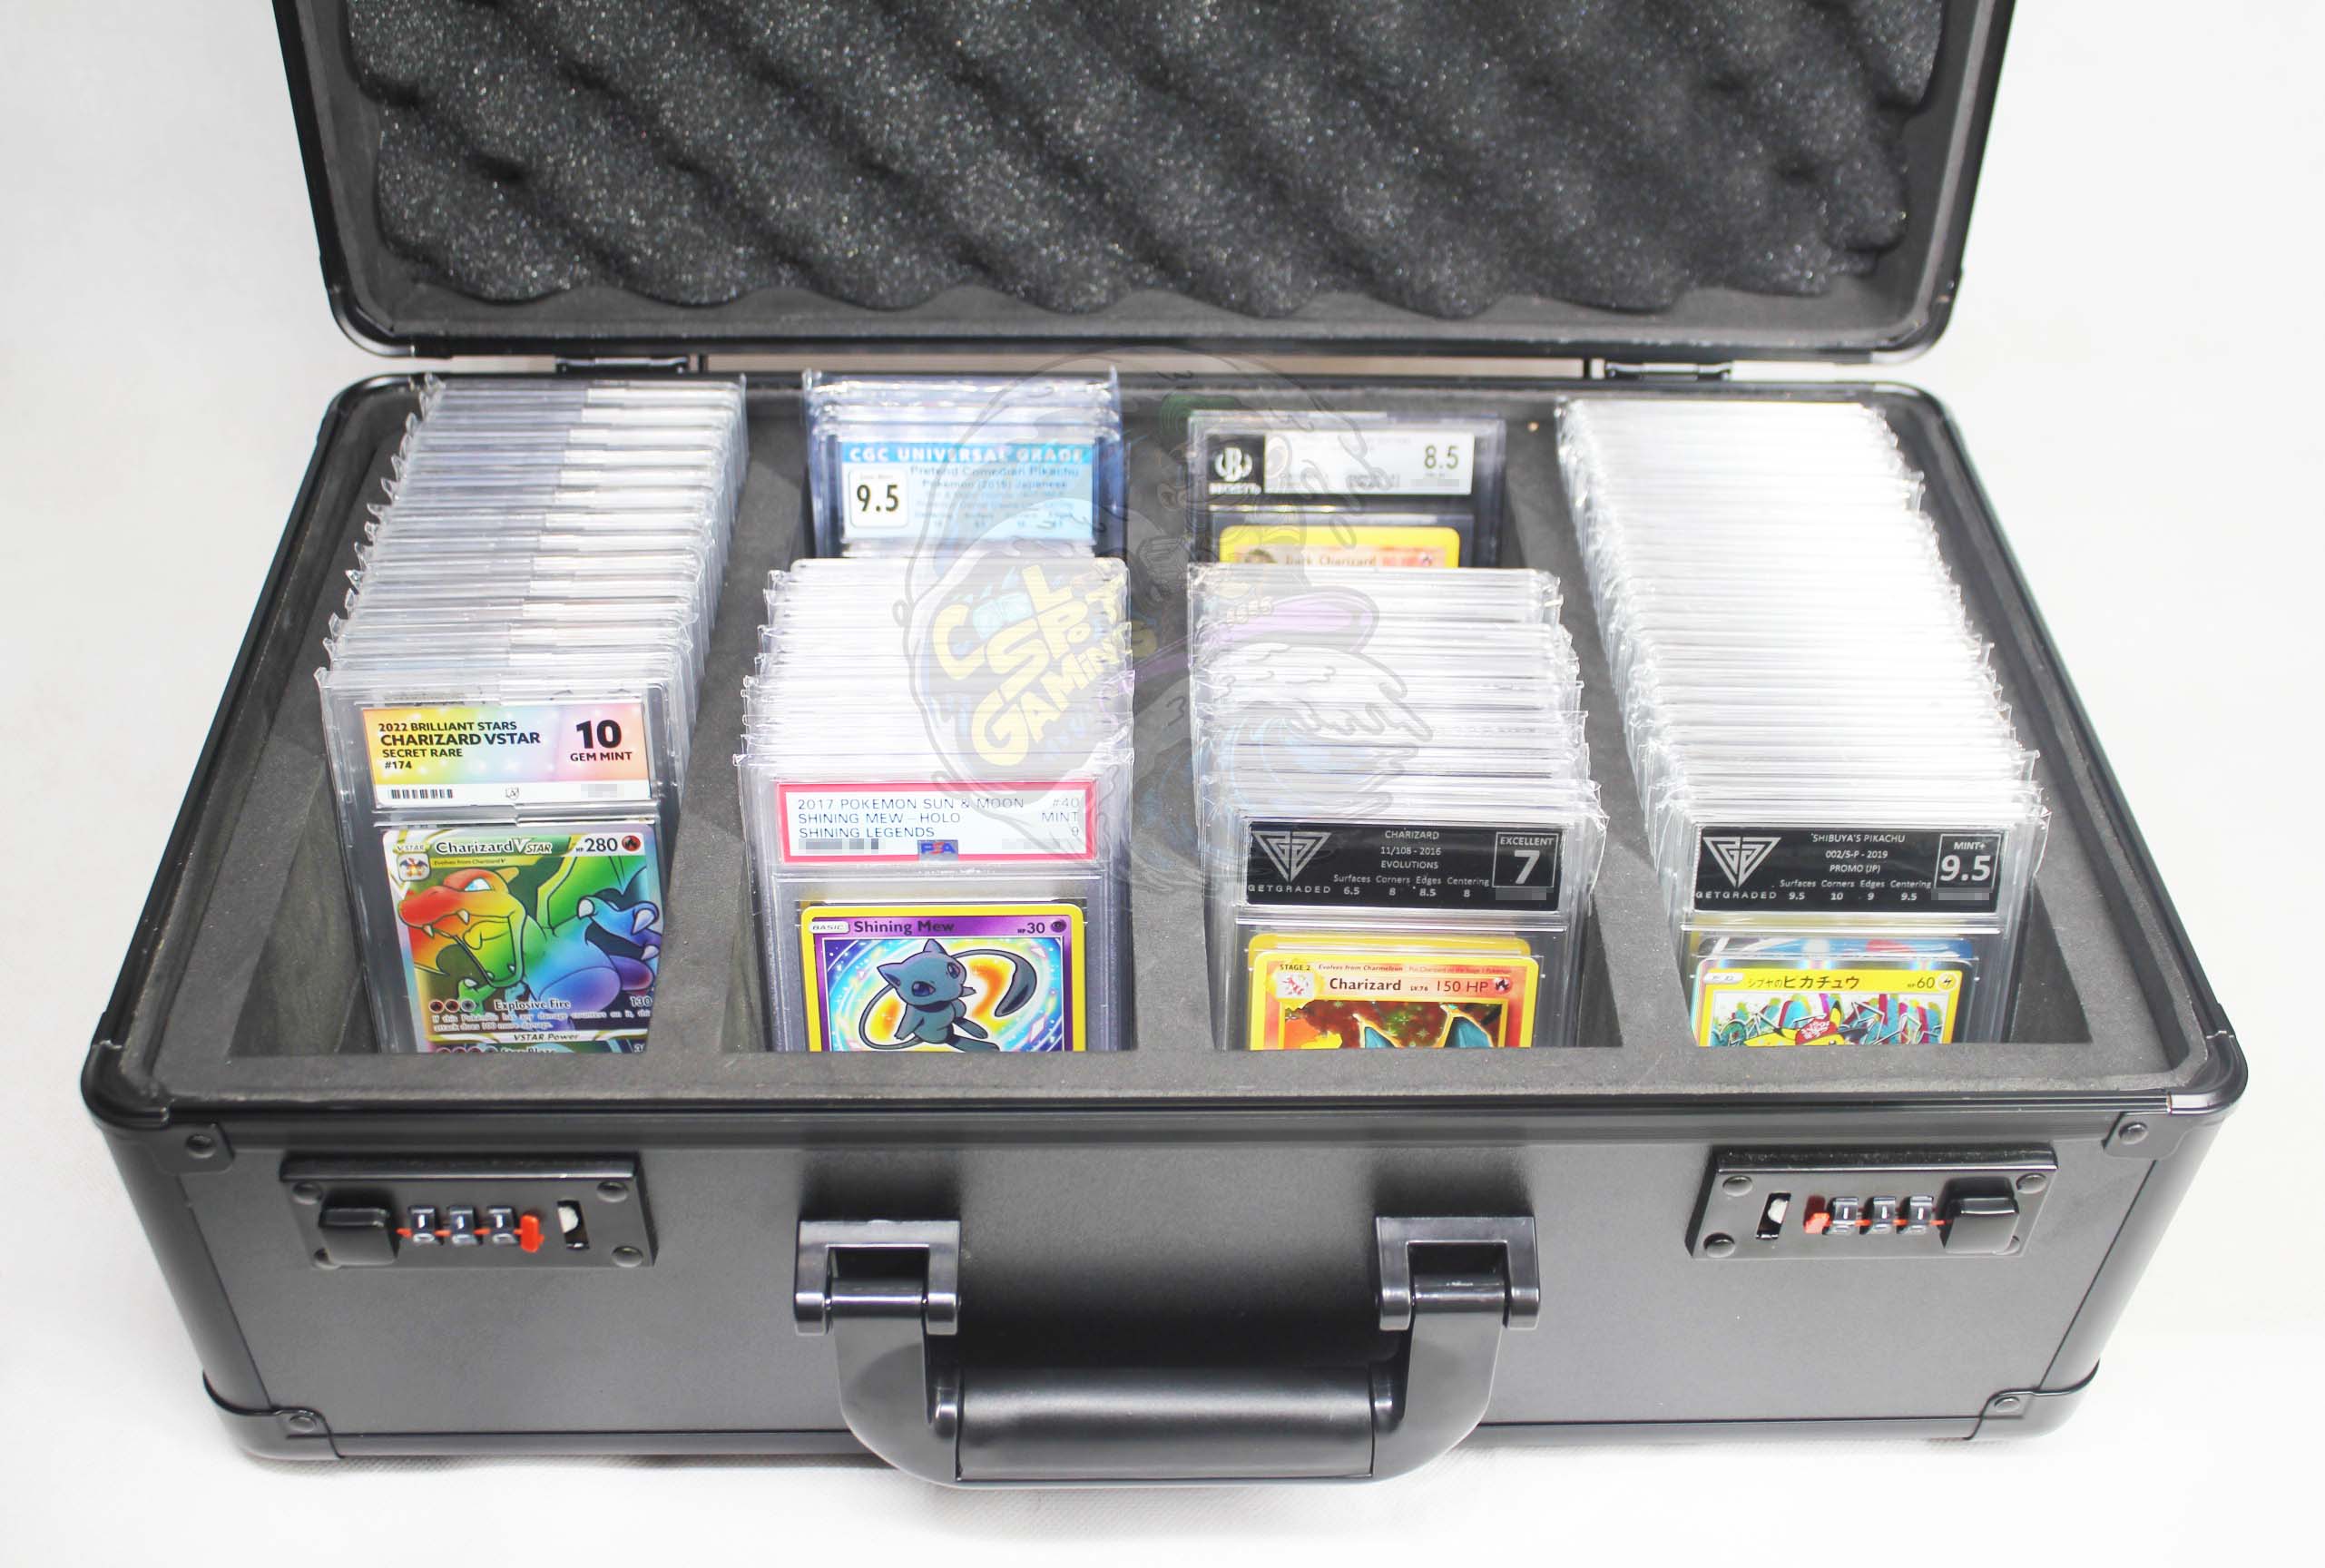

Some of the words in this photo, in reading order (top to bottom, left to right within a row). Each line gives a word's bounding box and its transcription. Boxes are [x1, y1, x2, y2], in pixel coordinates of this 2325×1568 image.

[849, 447, 888, 463] CGC
[1424, 444, 1459, 470] 8.5
[856, 484, 900, 513] 9.5
[378, 722, 408, 732] 2022
[410, 721, 475, 731] BRILLIANT
[477, 721, 517, 730] STARS
[380, 733, 482, 746] CHARIZARD
[485, 732, 541, 745] VSTAR
[575, 718, 623, 750] 10
[382, 748, 427, 759] SECRET
[430, 748, 464, 758] RARE
[570, 751, 599, 763] GEM
[600, 750, 633, 761] MINT
[384, 760, 412, 769] #174
[798, 799, 835, 810] 2017
[840, 799, 918, 810] POKEMON
[923, 798, 955, 809] SUN
[961, 798, 971, 808] &
[977, 798, 1025, 808] MOON
[1053, 797, 1080, 808] #40
[798, 813, 860, 824] SHINING
[866, 812, 905, 824] MEW
[919, 812, 962, 823] HOLO
[1041, 811, 1079, 822] MINT
[798, 828, 861, 838] SHINING
[866, 827, 936, 838] LEGENDS
[1071, 826, 1080, 838] 9
[1385, 830, 1440, 840] CHARIZARD
[1500, 836, 1555, 847] EXCELLENT
[1812, 834, 1861, 843] SHIBUYA'S
[1863, 834, 1906, 843] PIKACHU
[436, 839, 513, 854] Charizard
[584, 838, 618, 852] 280
[920, 842, 956, 855] PSA
[1953, 841, 1987, 850] MINT+
[1380, 846, 1412, 856] 11/108
[1419, 847, 1442, 856] 2016
[1825, 849, 1859, 859] 002/S-P
[1867, 849, 1888, 858] 2019
[1380, 860, 1439, 869] EVOLUTIONS
[1514, 849, 1541, 885] 7
[1830, 864, 1863, 873] PROMO
[1865, 864, 1881, 874] (JP)
[1939, 855, 1992, 882] 9.5
[1333, 874, 1371, 883] Surfaces
[1376, 875, 1410, 884] Corners
[1416, 876, 1442, 886] Edges
[1447, 877, 1490, 887] Centering
[1780, 879, 1817, 887] Surfaces
[1820, 879, 1856, 887] Corners
[1860, 879, 1885, 889] Edges
[1889, 879, 1932, 890] Centering
[1248, 884, 1331, 895] GETGRADED
[1343, 887, 1360, 895] 6.5
[1388, 887, 1397, 896] 8
[1419, 888, 1437, 897] 8.5
[1463, 889, 1470, 897] 8
[1695, 890, 1778, 900] GETGRADED
[1789, 892, 1806, 900] 9.5
[1830, 892, 1844, 900] 10
[1867, 892, 1875, 901] 9
[1900, 892, 1918, 901] 9.5
[854, 920, 913, 936] Shining
[917, 921, 955, 933] Mew
[1026, 922, 1045, 935] 30
[1329, 977, 1402, 991] Charizard
[1437, 980, 1461, 992] 150
[1466, 981, 1489, 993] HP
[1917, 976, 1936, 989] 60
[494, 999, 546, 1013] Explosive
[549, 999, 572, 1010] Fire
[514, 1033, 544, 1041] VSTAR
[547, 1033, 578, 1041] Power
